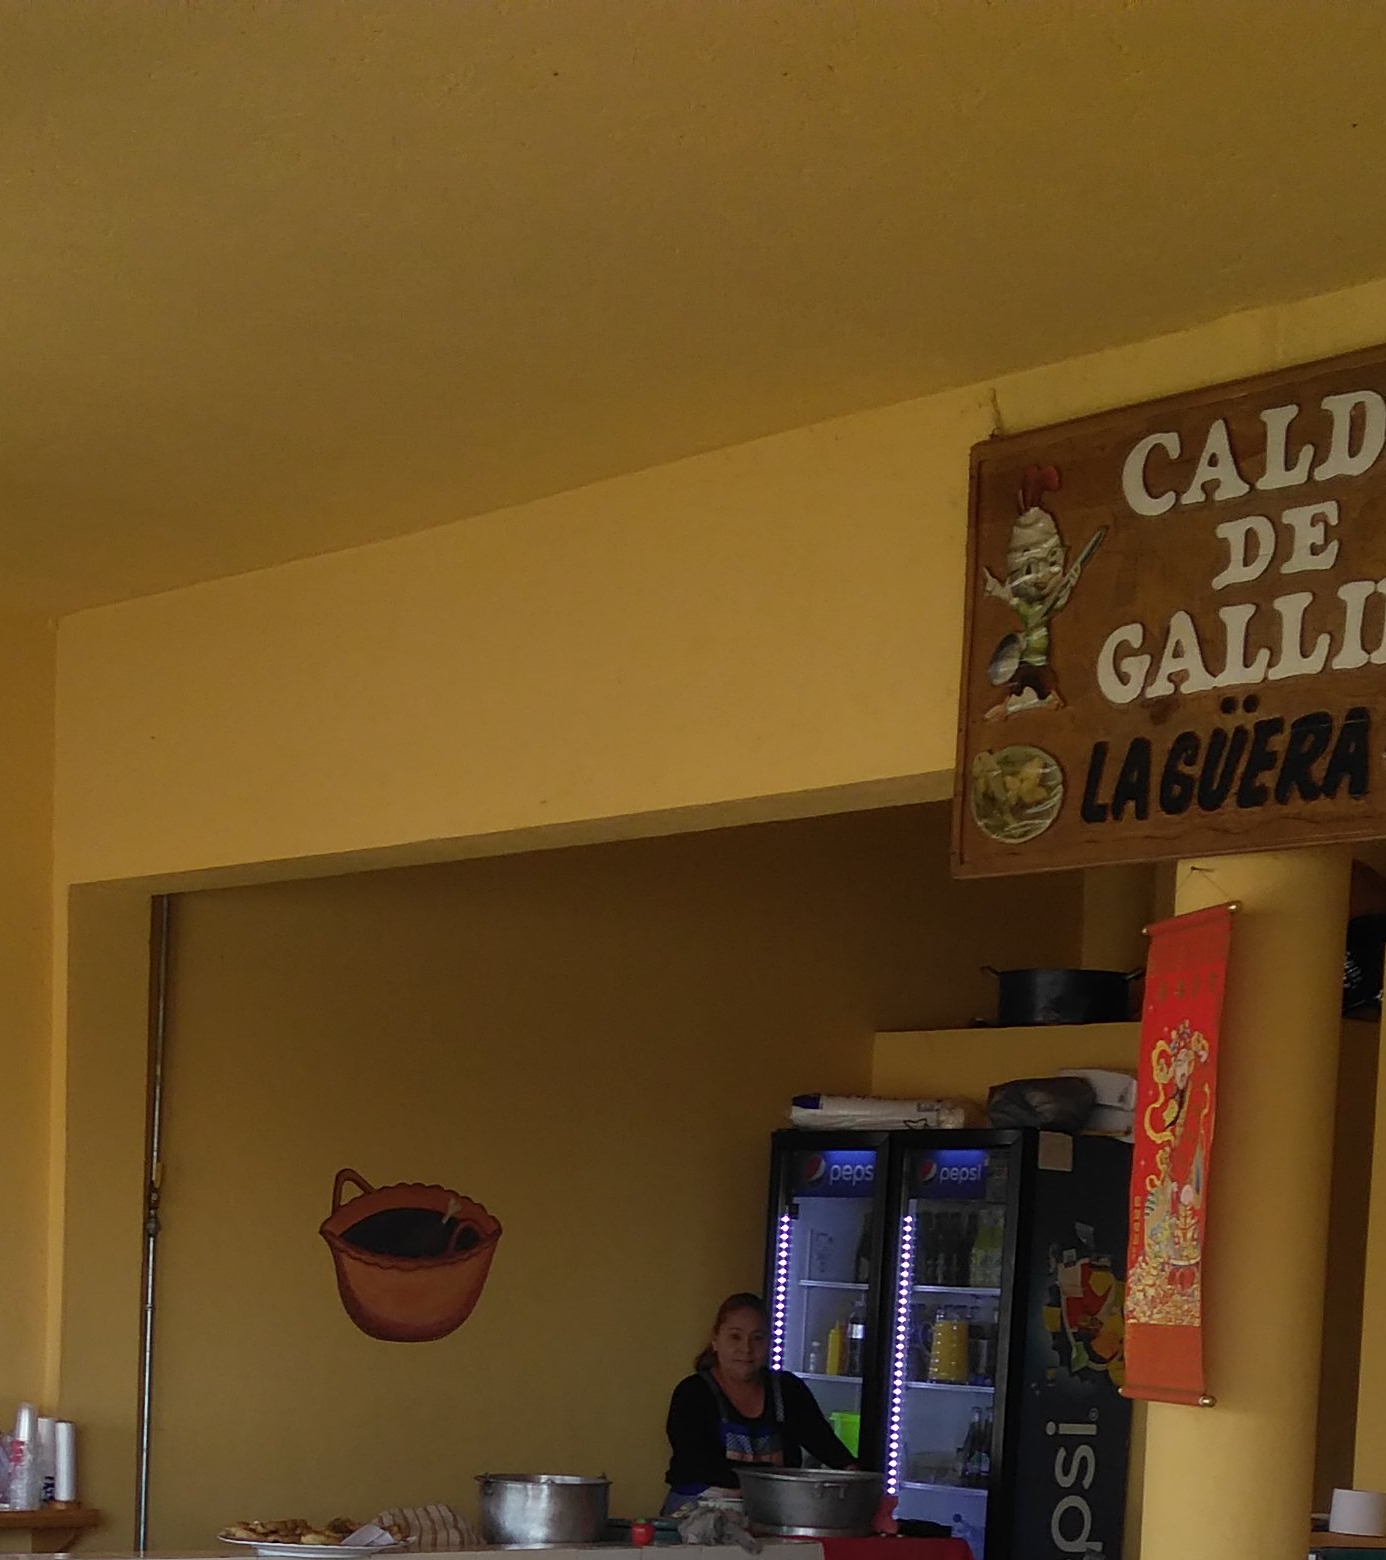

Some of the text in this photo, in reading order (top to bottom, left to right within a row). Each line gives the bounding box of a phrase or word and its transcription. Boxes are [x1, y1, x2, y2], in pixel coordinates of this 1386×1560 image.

[1211, 500, 1340, 591] DE
[829, 1163, 875, 1187] peps
[939, 1164, 982, 1185] pepsi
